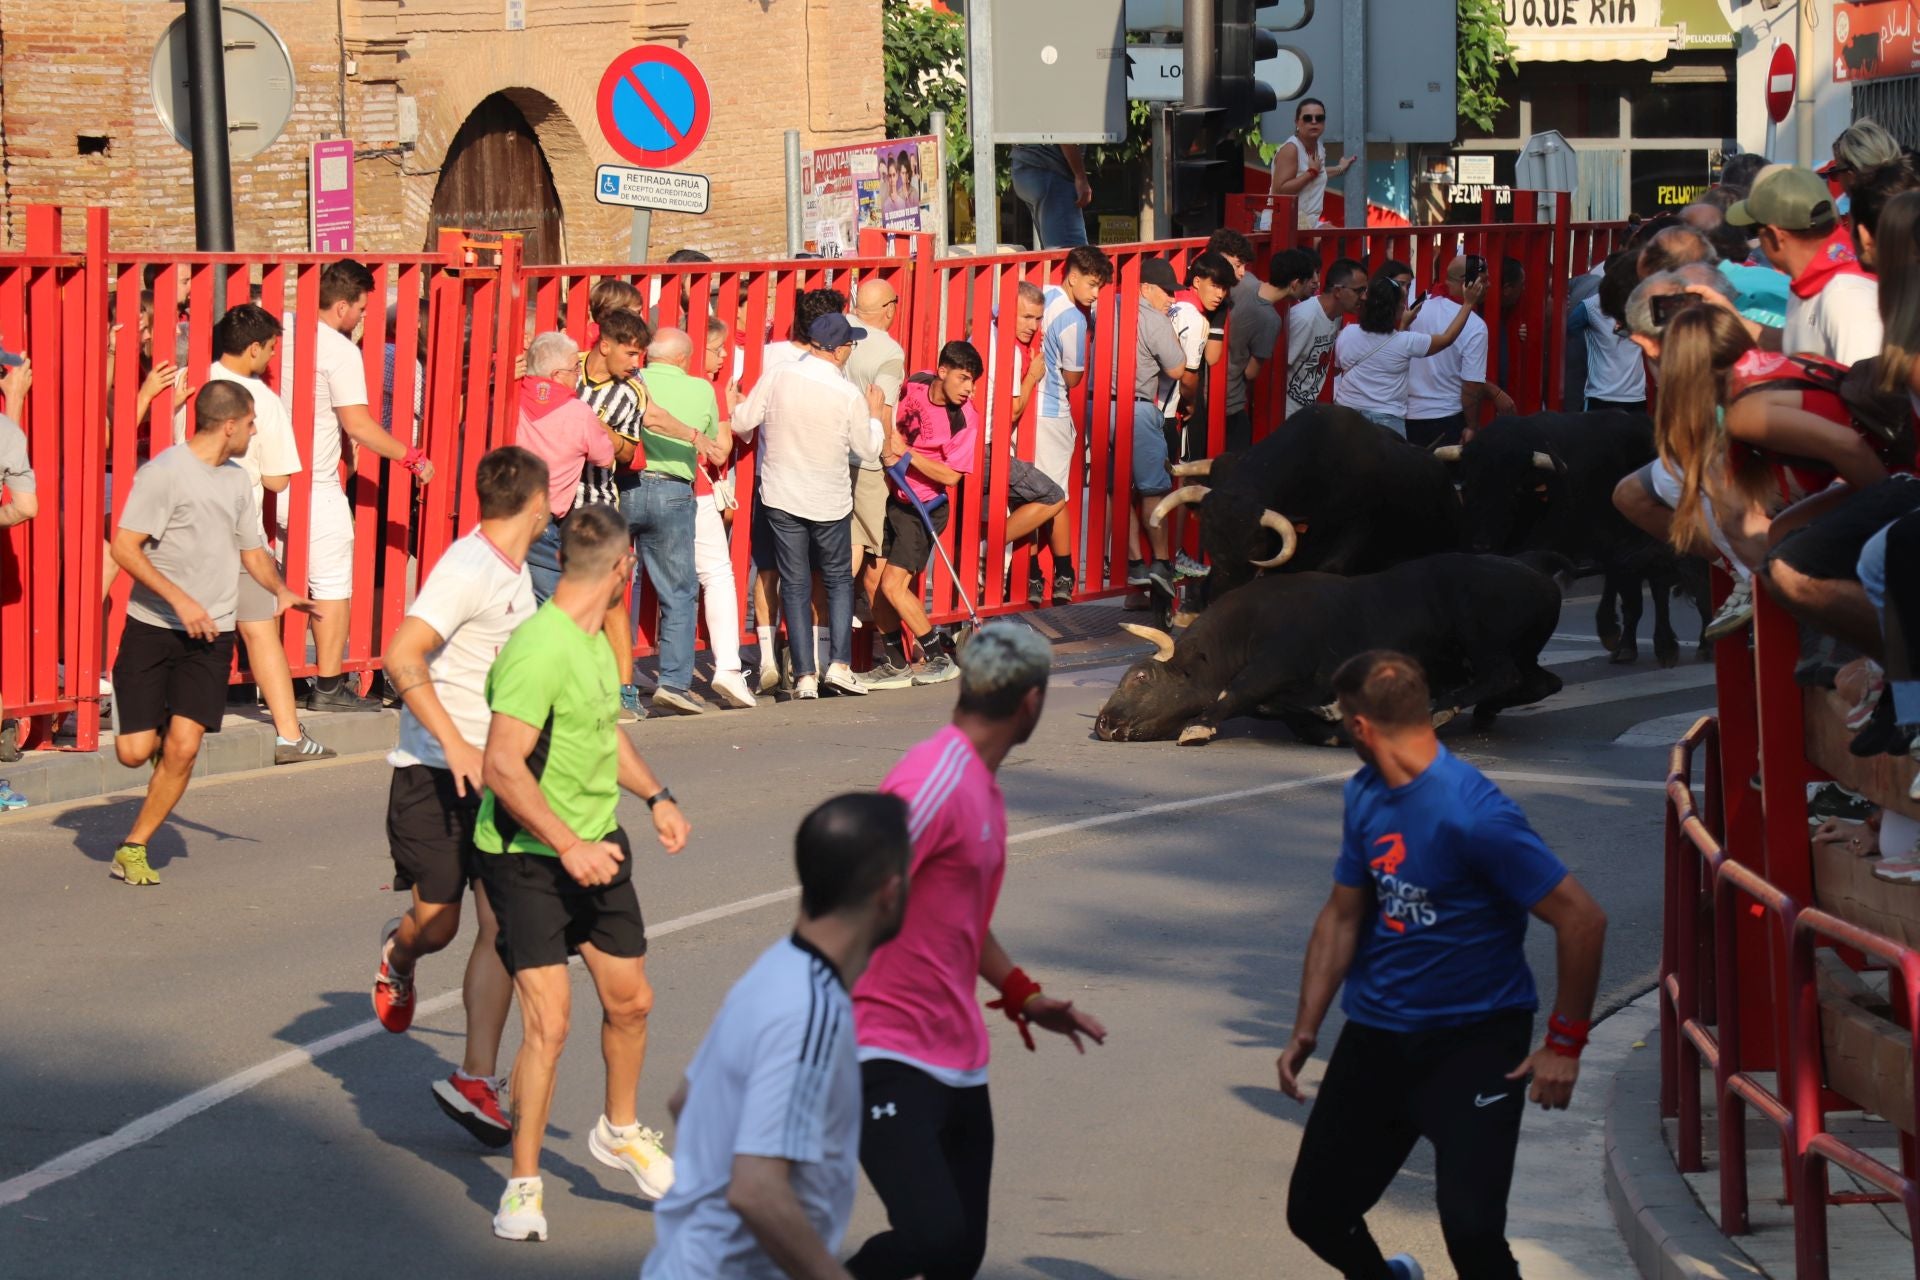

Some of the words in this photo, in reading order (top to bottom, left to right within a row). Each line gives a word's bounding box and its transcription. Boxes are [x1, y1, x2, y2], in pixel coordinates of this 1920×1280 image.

[1160, 65, 1183, 78] LO
[626, 173, 671, 186] RETIRADA
[623, 184, 654, 194] EXCEPTO
[655, 188, 702, 199] ACREDITADOS
[1448, 185, 1511, 204] PELUQRIA
[631, 194, 667, 204] MOVILIDAD
[669, 199, 703, 208] REDUCIDA
